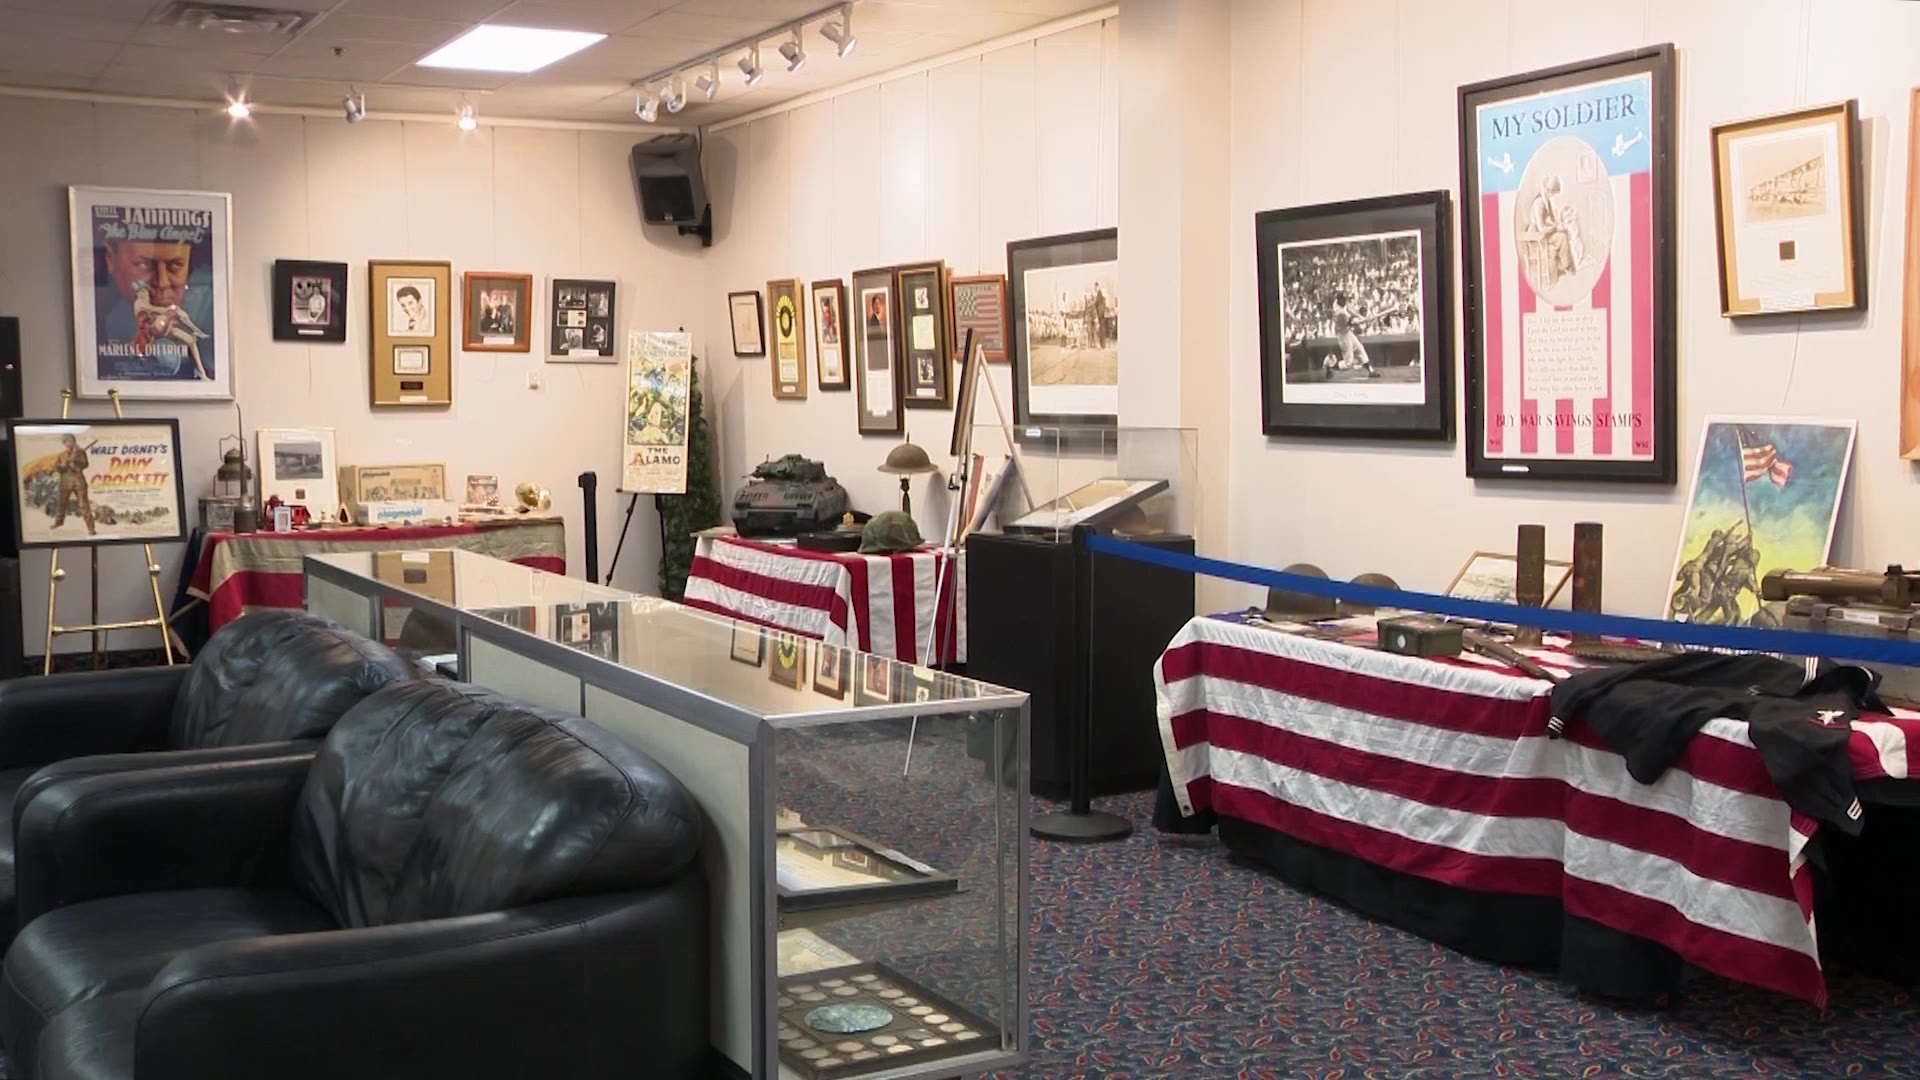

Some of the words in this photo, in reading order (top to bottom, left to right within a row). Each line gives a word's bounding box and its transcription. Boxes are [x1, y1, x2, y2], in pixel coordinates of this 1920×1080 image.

[1491, 113, 1526, 139] MY
[1531, 93, 1636, 134] SOLDIER
[121, 208, 211, 228] JANNINGS
[98, 344, 142, 357] MARLENE
[144, 343, 189, 357] DIETRICH
[1496, 414, 1515, 427] BUY
[1519, 413, 1542, 427] WAR
[1546, 413, 1592, 427] SAVINGS
[1596, 413, 1642, 428] STAMPS
[90, 446, 119, 455] WALT
[121, 443, 168, 455] DISNEY'S
[110, 456, 153, 472] DAVY
[629, 452, 681, 466] ALAMO
[90, 472, 169, 488] CROCKETT
